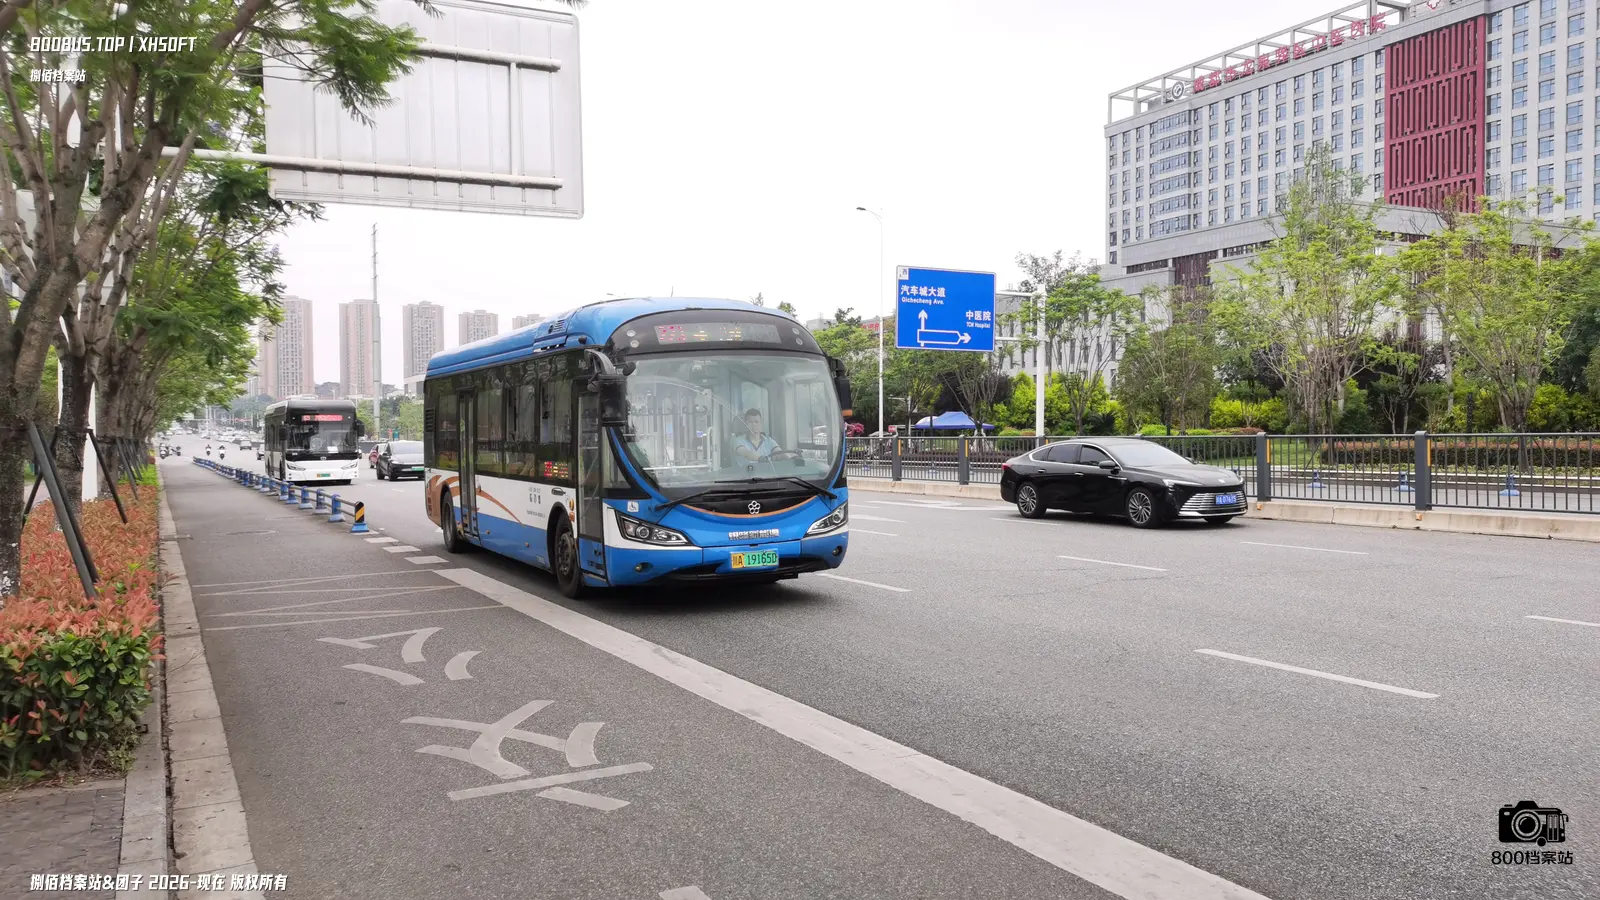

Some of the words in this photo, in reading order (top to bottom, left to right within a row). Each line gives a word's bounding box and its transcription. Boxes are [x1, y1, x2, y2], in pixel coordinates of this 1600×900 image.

[901, 285, 945, 297] 汽车城大道
[966, 310, 991, 320] 中医院
